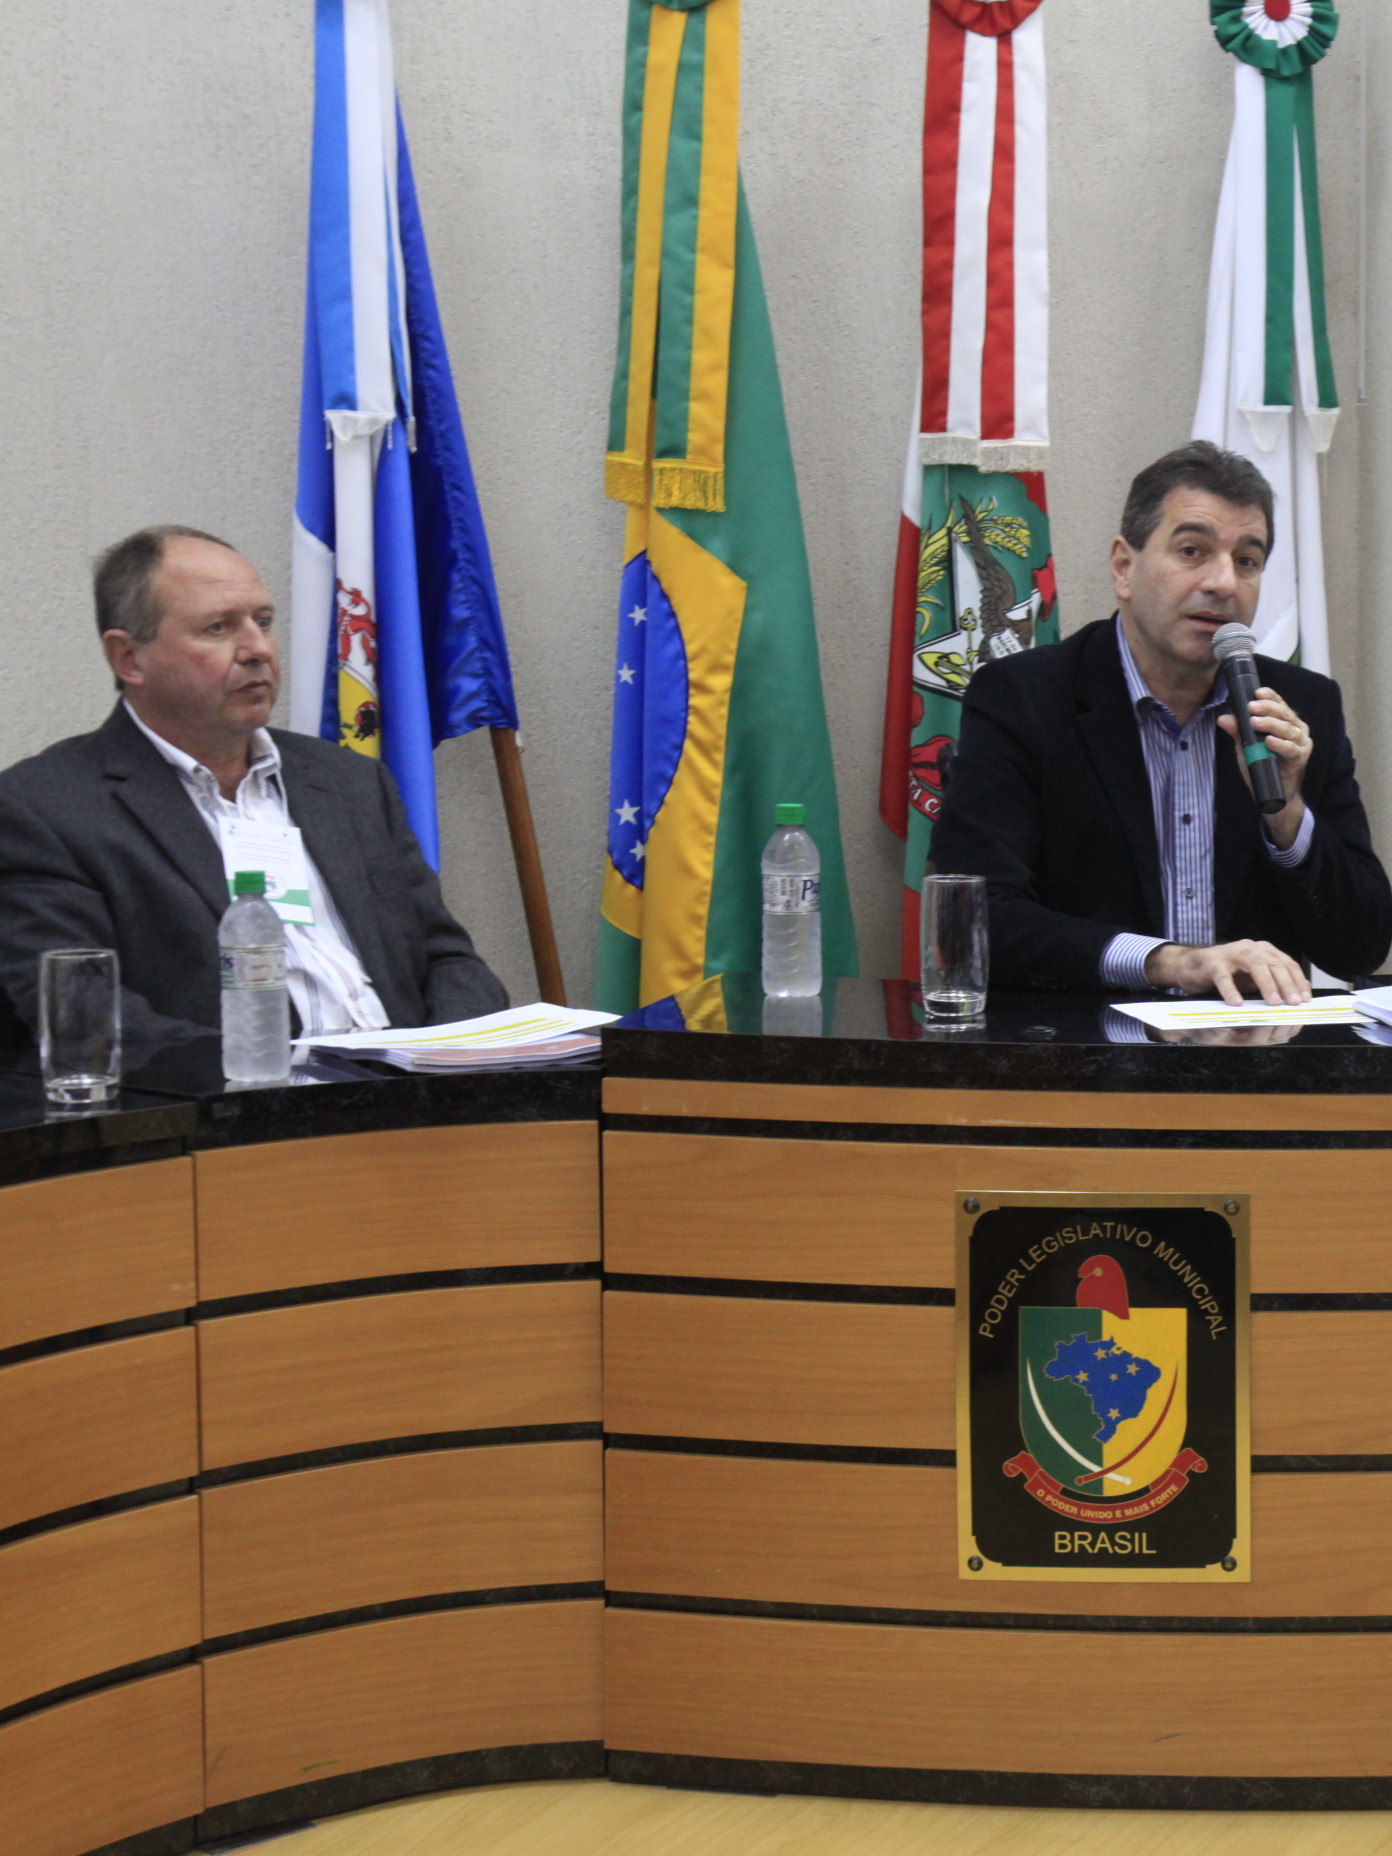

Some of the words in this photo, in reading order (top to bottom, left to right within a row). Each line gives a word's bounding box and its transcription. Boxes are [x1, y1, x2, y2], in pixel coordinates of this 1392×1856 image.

[978, 1268, 1026, 1339] PODER
[1018, 1221, 1153, 1272] LEGISLATIVO
[1153, 1240, 1228, 1341] MUNICIPAL
[1036, 1488, 1045, 1498] O
[1045, 1494, 1078, 1516] PODER
[1080, 1508, 1113, 1519] UNIDO
[1124, 1503, 1150, 1517] MAIS
[1150, 1483, 1180, 1508] FORTE
[1053, 1531, 1158, 1555] BRASIL
